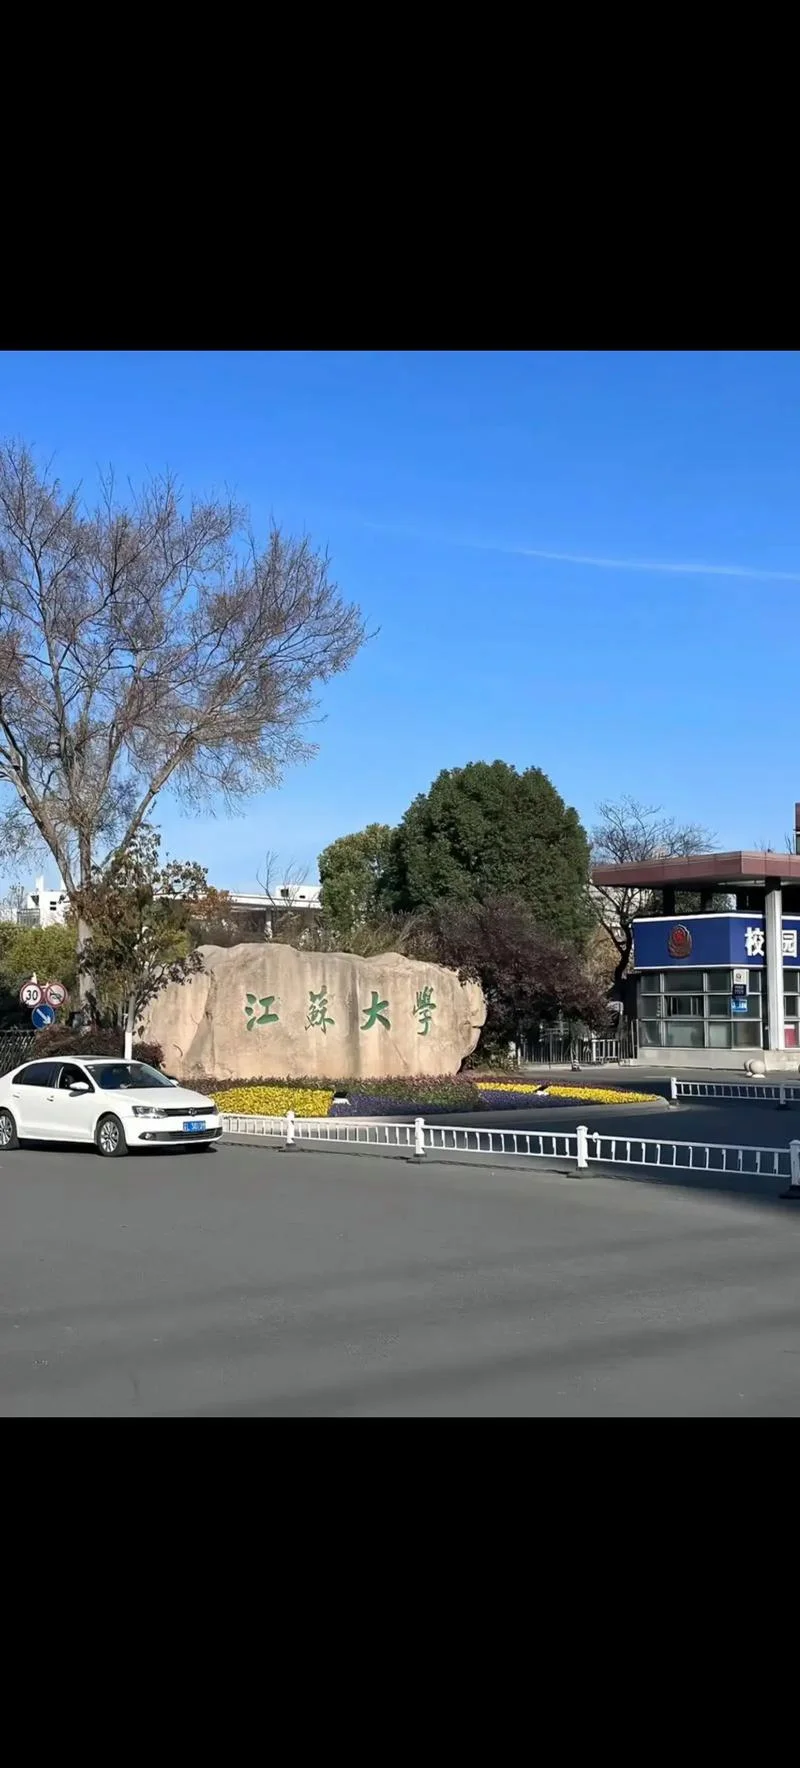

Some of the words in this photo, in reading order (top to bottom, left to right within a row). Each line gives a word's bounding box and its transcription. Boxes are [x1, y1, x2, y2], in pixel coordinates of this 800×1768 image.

[26, 990, 38, 1000] 30
[245, 985, 436, 1036] 江蘇大學
